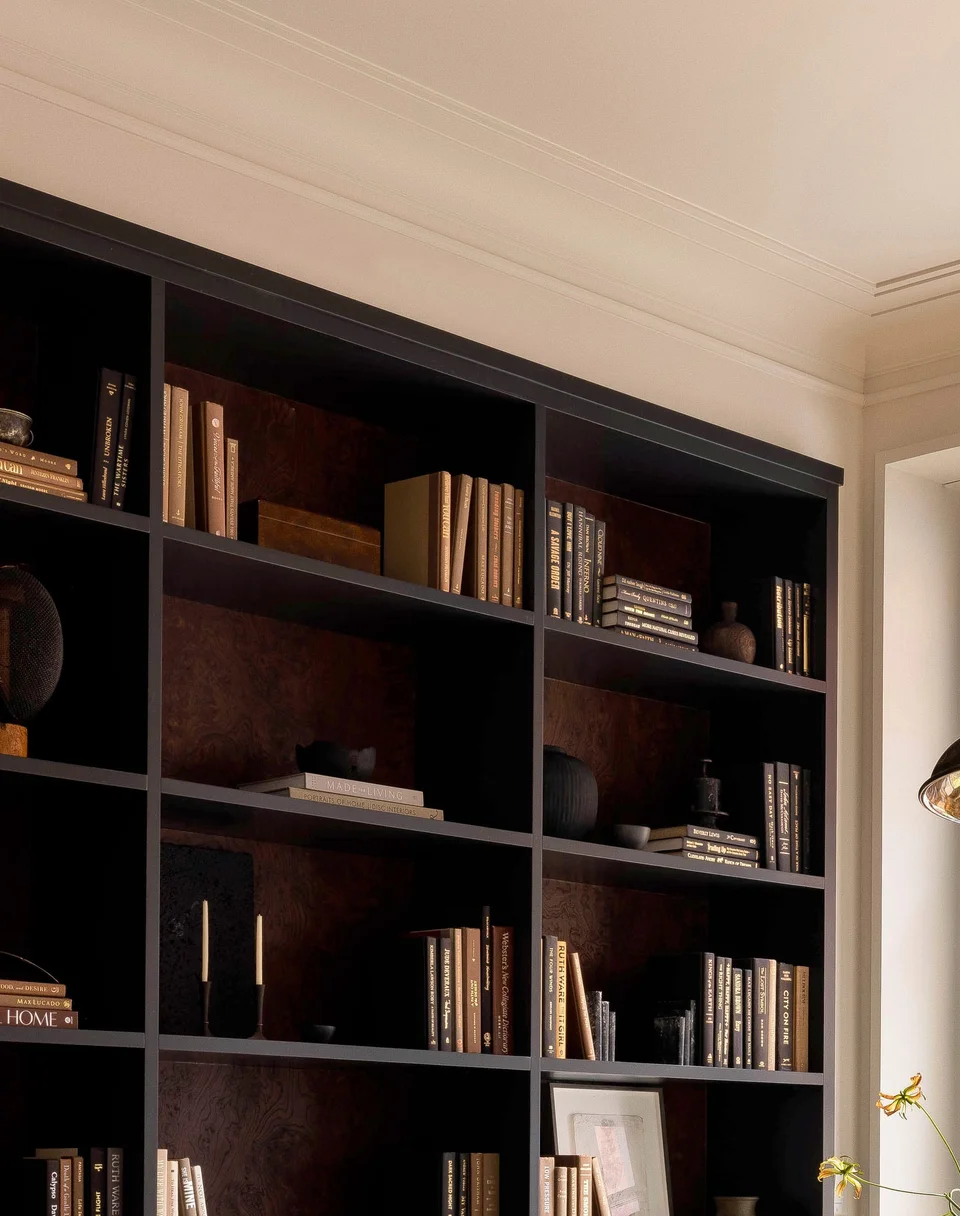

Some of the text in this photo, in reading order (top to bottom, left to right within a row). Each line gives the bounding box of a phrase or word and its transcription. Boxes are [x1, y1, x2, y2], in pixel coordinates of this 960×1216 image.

[103, 416, 112, 457] UNBROKEN
[115, 444, 124, 479] WARTIME
[121, 458, 129, 488] SISTERS
[551, 536, 560, 564] SAVAGE
[551, 565, 560, 590] ORDER
[776, 585, 784, 629] Retribution
[641, 622, 696, 642] MORE NATURAL CURES REVEALED
[326, 780, 404, 801] MADE LIVING
[304, 793, 417, 816] PORTRAITS OF HOME DISC INTERIORS
[707, 842, 721, 853] Trading
[720, 846, 727, 855] Up
[501, 932, 509, 970] Webster's
[32, 999, 61, 1007] LUCADO
[501, 986, 510, 1019] Collegiate
[7, 1009, 58, 1027] HOME
[558, 1015, 565, 1023] IT
[783, 1011, 789, 1026] ON
[501, 1019, 510, 1054] Dictionary
[111, 1153, 120, 1183] RUTH
[157, 1171, 165, 1187] LIFE
[49, 1171, 58, 1199] Calypso
[157, 1188, 165, 1206] WITH
[183, 1181, 196, 1210] MINE
[111, 1185, 120, 1216] WARE
[461, 1195, 466, 1205] MY
